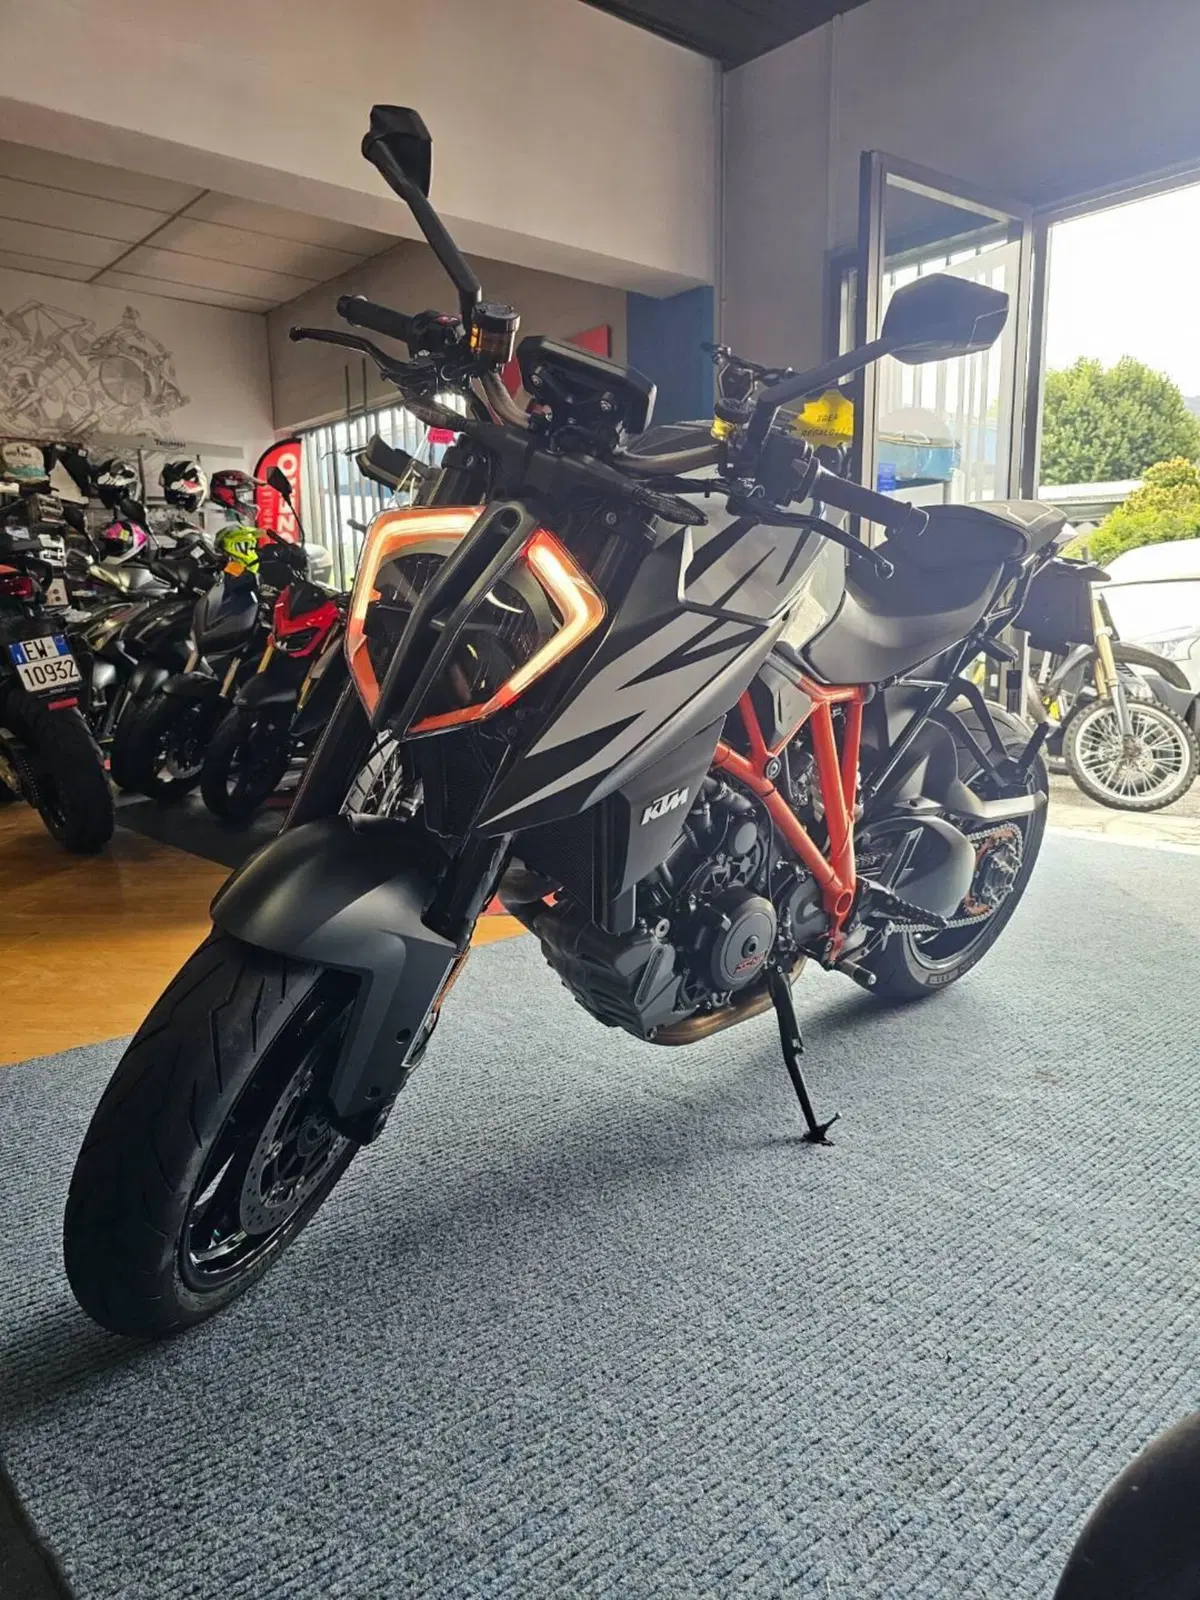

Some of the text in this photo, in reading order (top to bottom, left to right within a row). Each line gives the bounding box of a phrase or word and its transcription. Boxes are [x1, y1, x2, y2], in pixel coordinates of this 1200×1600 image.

[23, 639, 48, 661] EW
[24, 659, 79, 687] 10932
[640, 786, 689, 826] KTM
